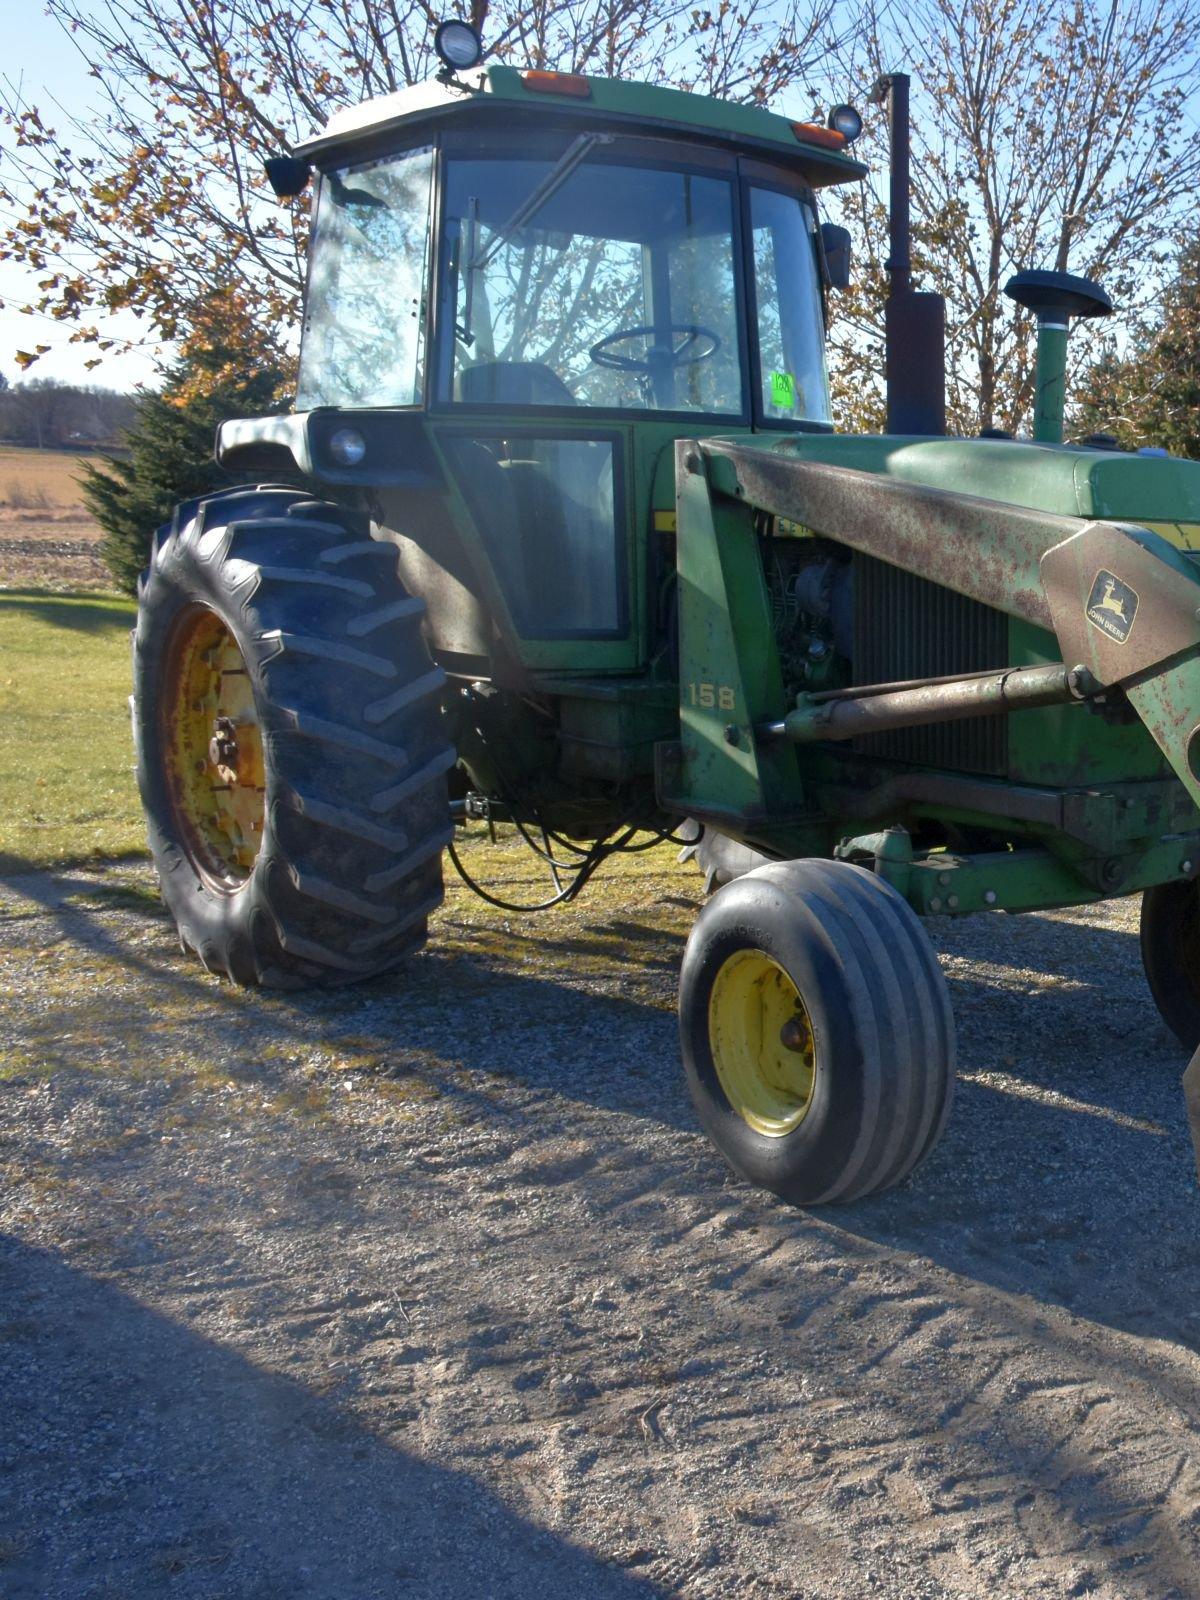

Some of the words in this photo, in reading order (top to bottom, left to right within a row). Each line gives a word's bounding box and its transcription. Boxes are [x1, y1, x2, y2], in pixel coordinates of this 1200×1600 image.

[1087, 608, 1106, 626] JOHN
[1103, 620, 1126, 641] DEERE
[689, 682, 736, 711] 158
